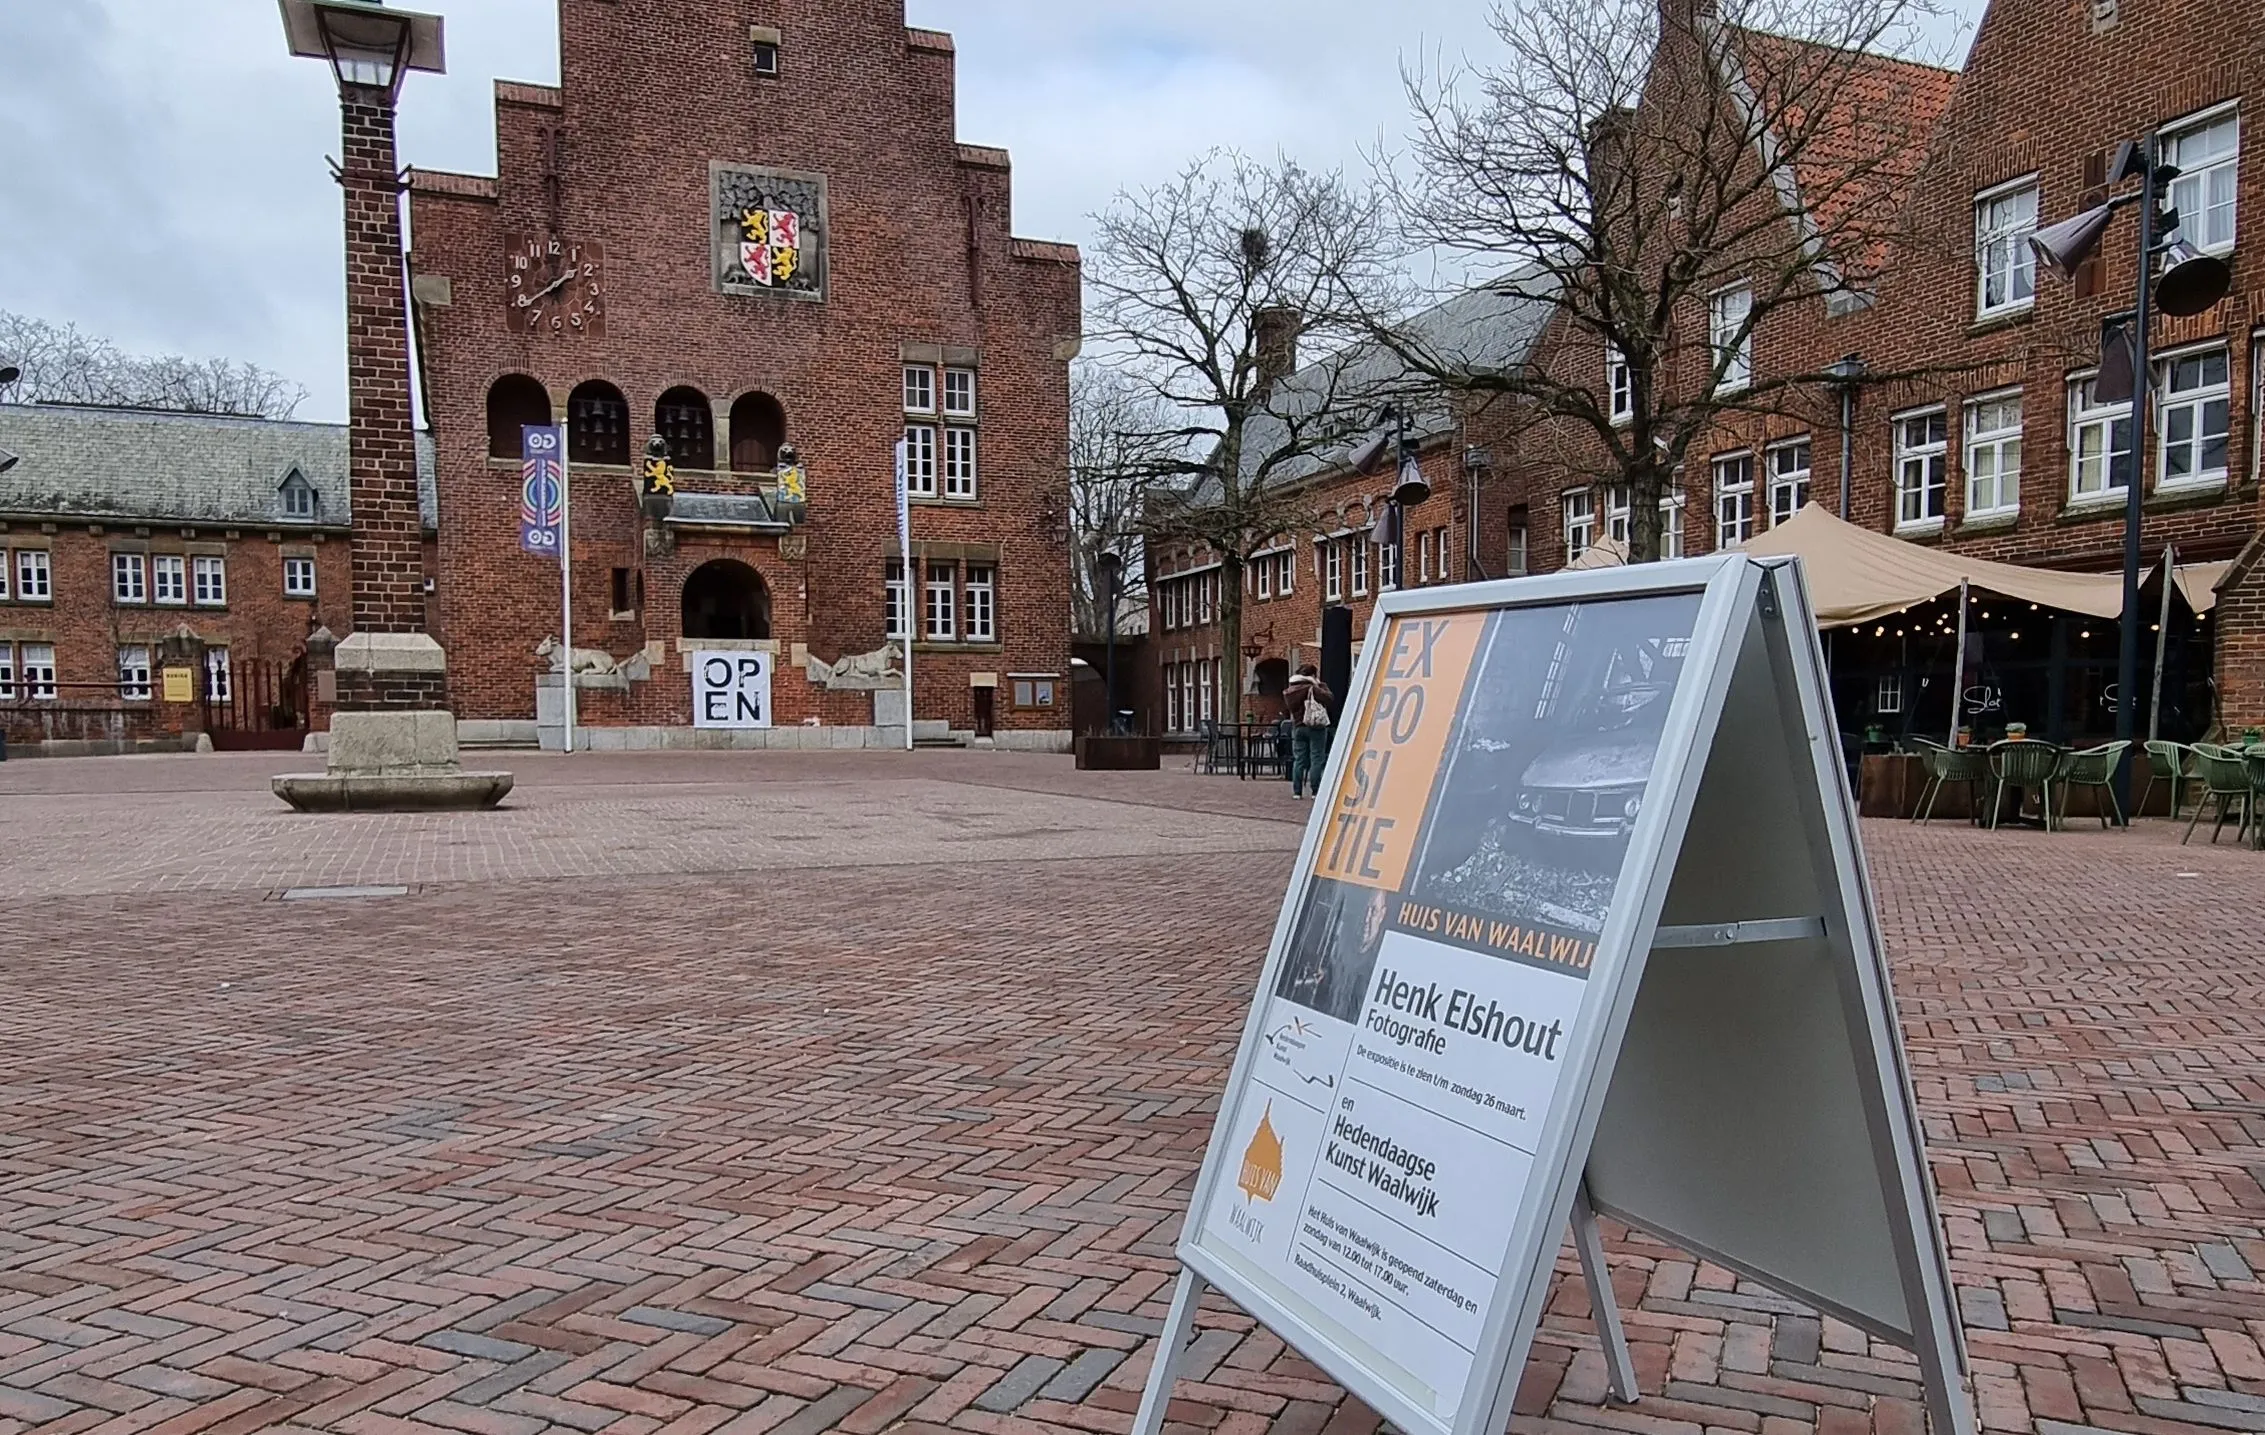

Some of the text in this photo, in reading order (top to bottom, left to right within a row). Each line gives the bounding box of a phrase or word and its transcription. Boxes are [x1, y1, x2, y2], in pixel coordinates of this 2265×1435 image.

[530, 244, 540, 258] 11
[548, 241, 560, 255] 12
[571, 249, 577, 262] 1
[515, 255, 528, 269] 10
[584, 263, 593, 276] 2
[511, 275, 521, 288] 9
[589, 283, 599, 296] 3
[517, 294, 527, 307] 8
[584, 300, 594, 314] 4
[532, 310, 541, 322] 7
[551, 316, 561, 329] 6
[571, 312, 581, 326] 5
[1384, 619, 1450, 679] EX
[703, 657, 761, 688] OP
[705, 691, 761, 721] EN
[1365, 684, 1425, 744] PO
[1343, 749, 1392, 809] SI
[1328, 813, 1396, 879] TIE
[1397, 902, 1596, 969] HUIS VAN WAALWIJ
[1373, 968, 1562, 1061] Henk Elshout
[1365, 1008, 1446, 1055] Fotografie
[1357, 1044, 1526, 1121] De expositie is te zien t/m zondag 26 maart.
[1341, 1096, 1355, 1112] en
[1333, 1114, 1436, 1181] Hedendaagse
[1325, 1140, 1440, 1218] Kunst Waalwijk
[1303, 1222, 1409, 1296] zondag van 12.00 tot 17.00 uur.
[1308, 1204, 1320, 1220] Het
[1335, 1222, 1348, 1238] van
[1348, 1228, 1381, 1257] Waalwijk
[1381, 1247, 1388, 1261] is
[1388, 1255, 1425, 1282] geopend
[1424, 1275, 1464, 1308] zaterdag
[1465, 1299, 1478, 1314] en
[1340, 1283, 1347, 1299] 2,
